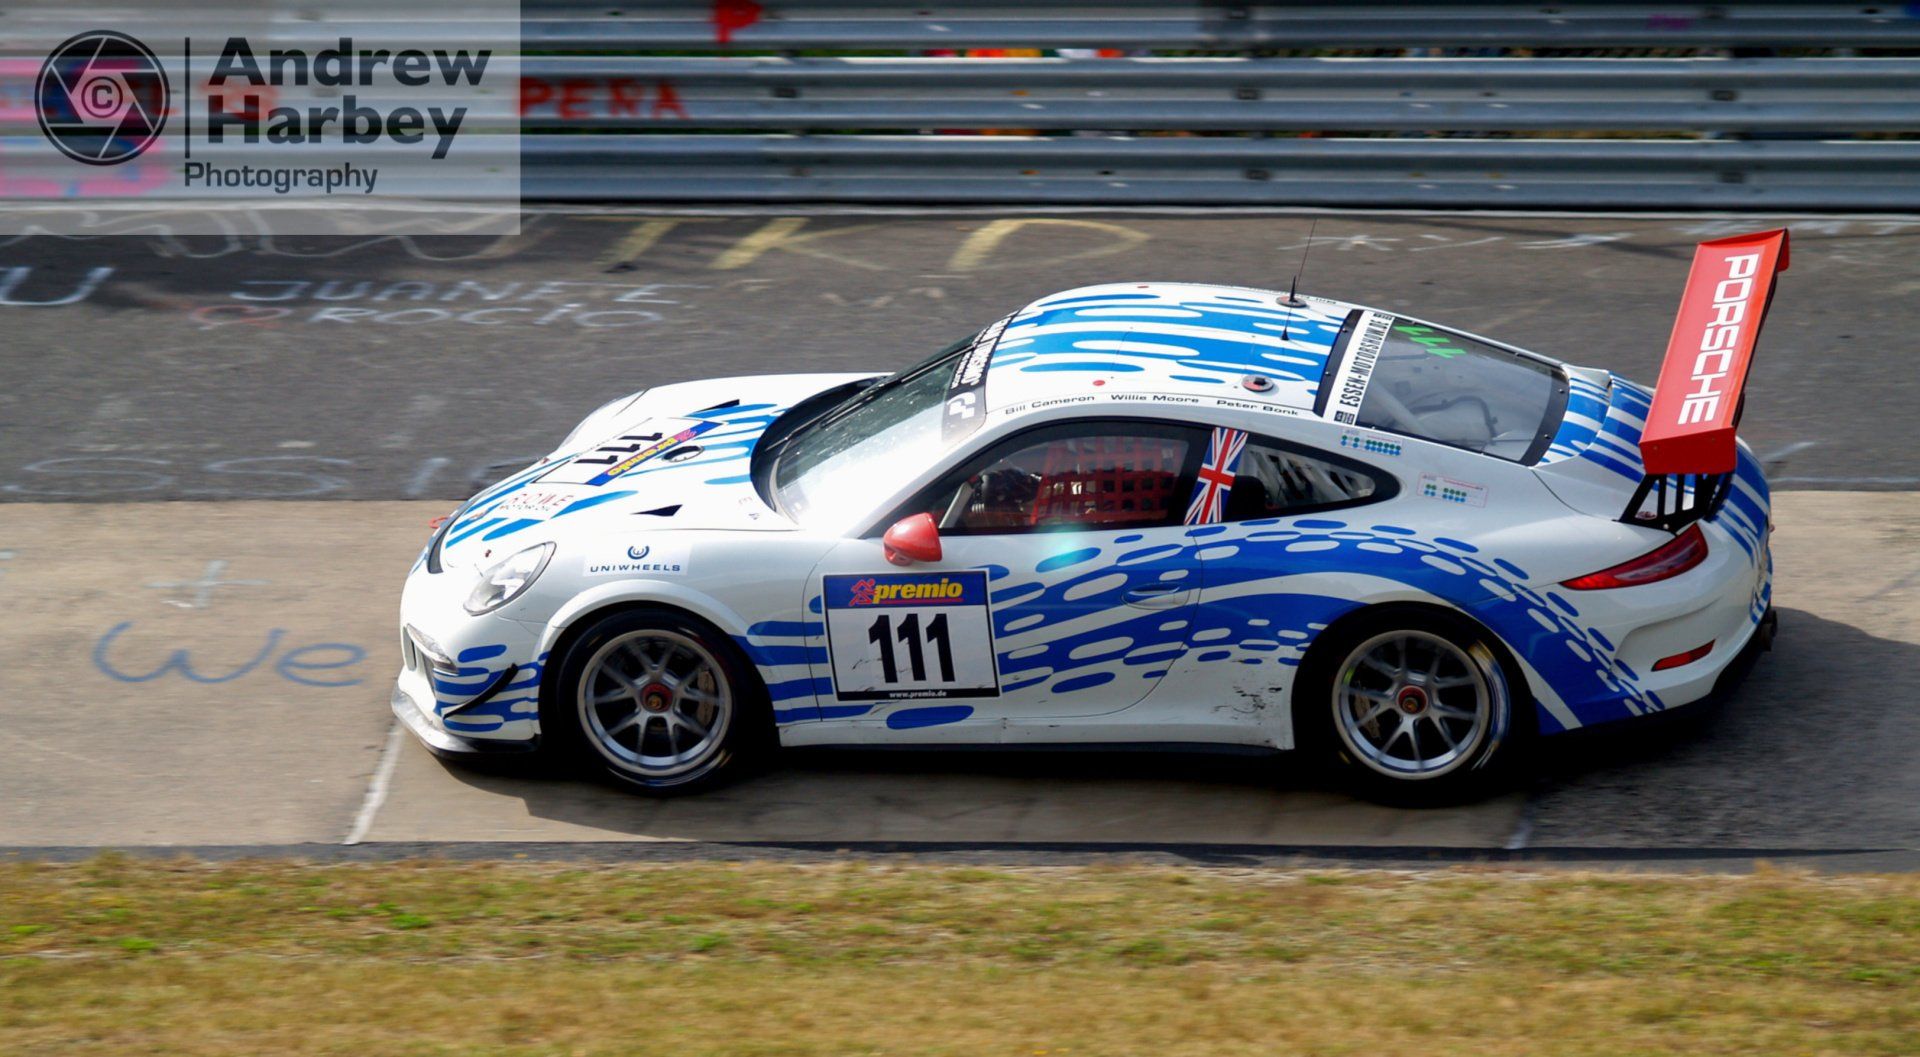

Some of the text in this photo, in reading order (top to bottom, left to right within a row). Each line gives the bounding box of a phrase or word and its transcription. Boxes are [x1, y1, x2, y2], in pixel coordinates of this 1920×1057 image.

[1677, 253, 1760, 426] PORSCHE
[1340, 319, 1390, 408] ESSEN-MOTORSHOW.DE
[1005, 396, 1095, 415] Bill Cameron
[1152, 395, 1199, 403] Moore
[1216, 400, 1257, 409] Peter
[573, 432, 663, 465] 111
[590, 564, 681, 573] UNIWHEELS
[872, 578, 963, 604] premio
[92, 620, 367, 687] We
[868, 613, 956, 684] 111
[889, 690, 947, 699] www.premio.de
